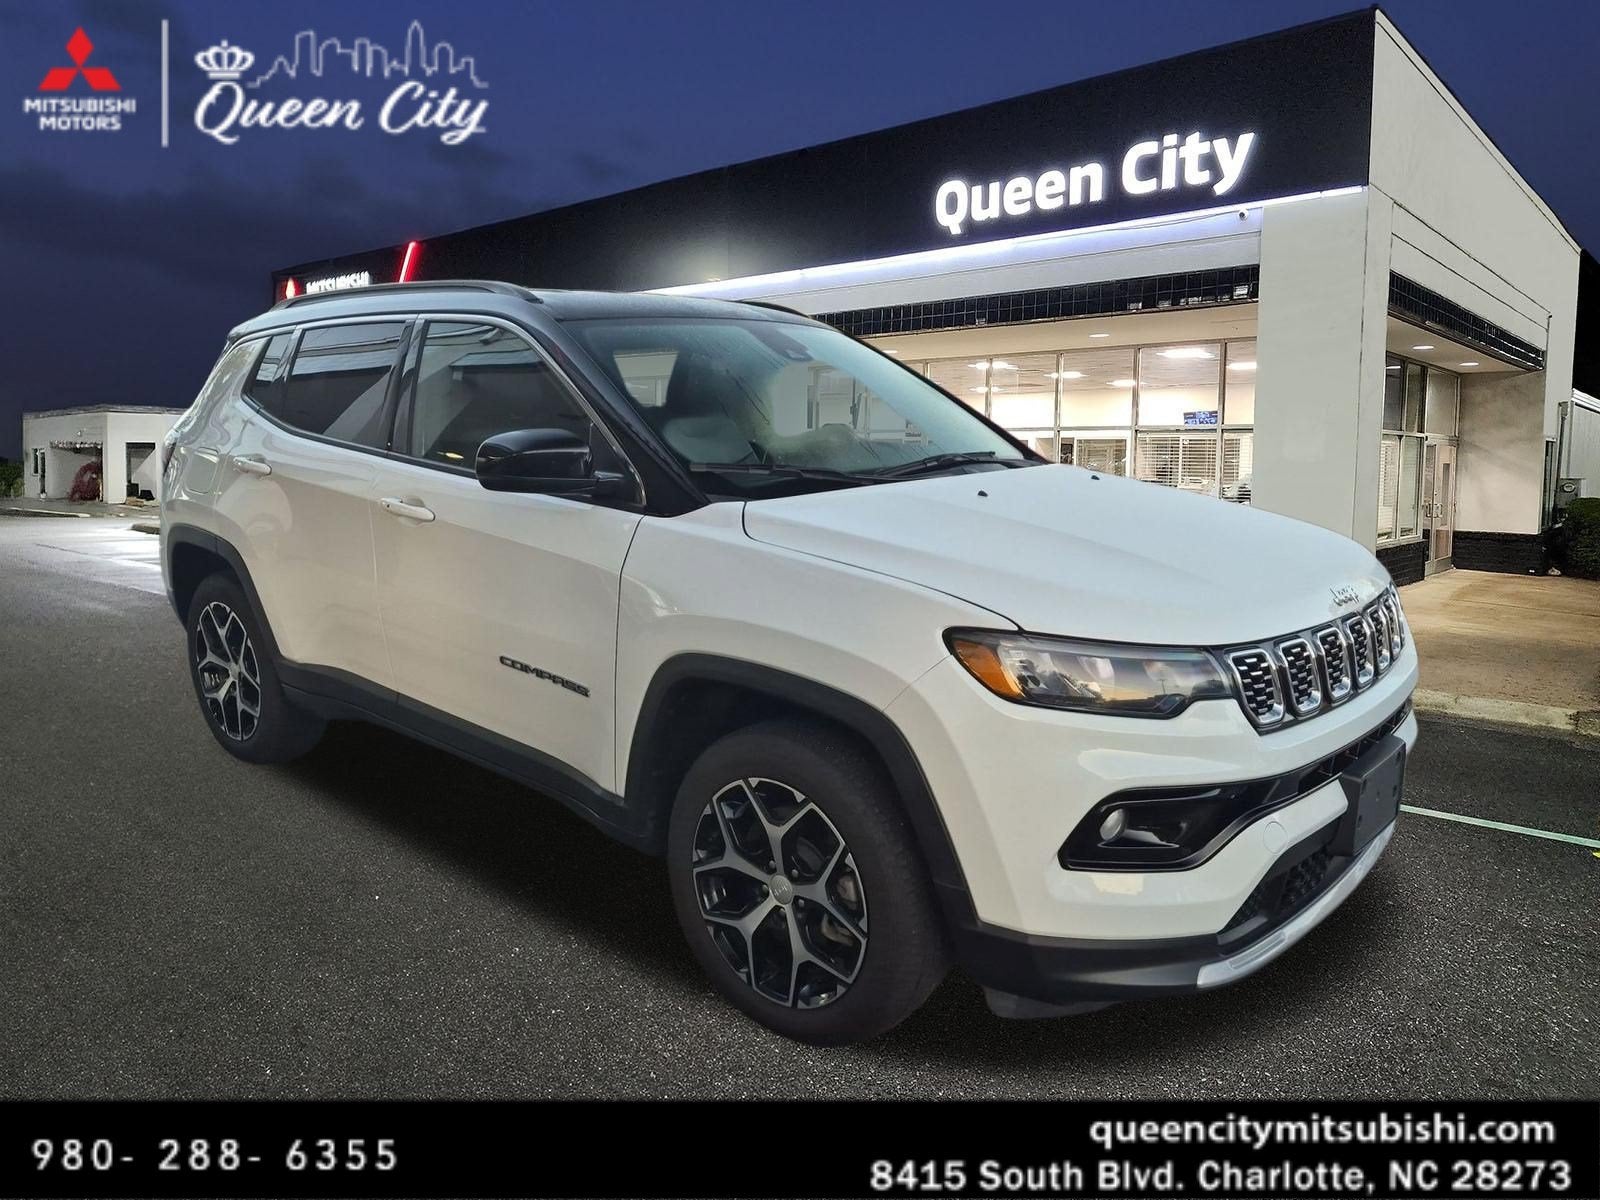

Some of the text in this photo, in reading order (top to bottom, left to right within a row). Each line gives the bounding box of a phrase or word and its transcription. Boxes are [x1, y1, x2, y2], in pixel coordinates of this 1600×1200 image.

[935, 131, 1256, 235] Queen City
[499, 655, 591, 698] COMPASS
